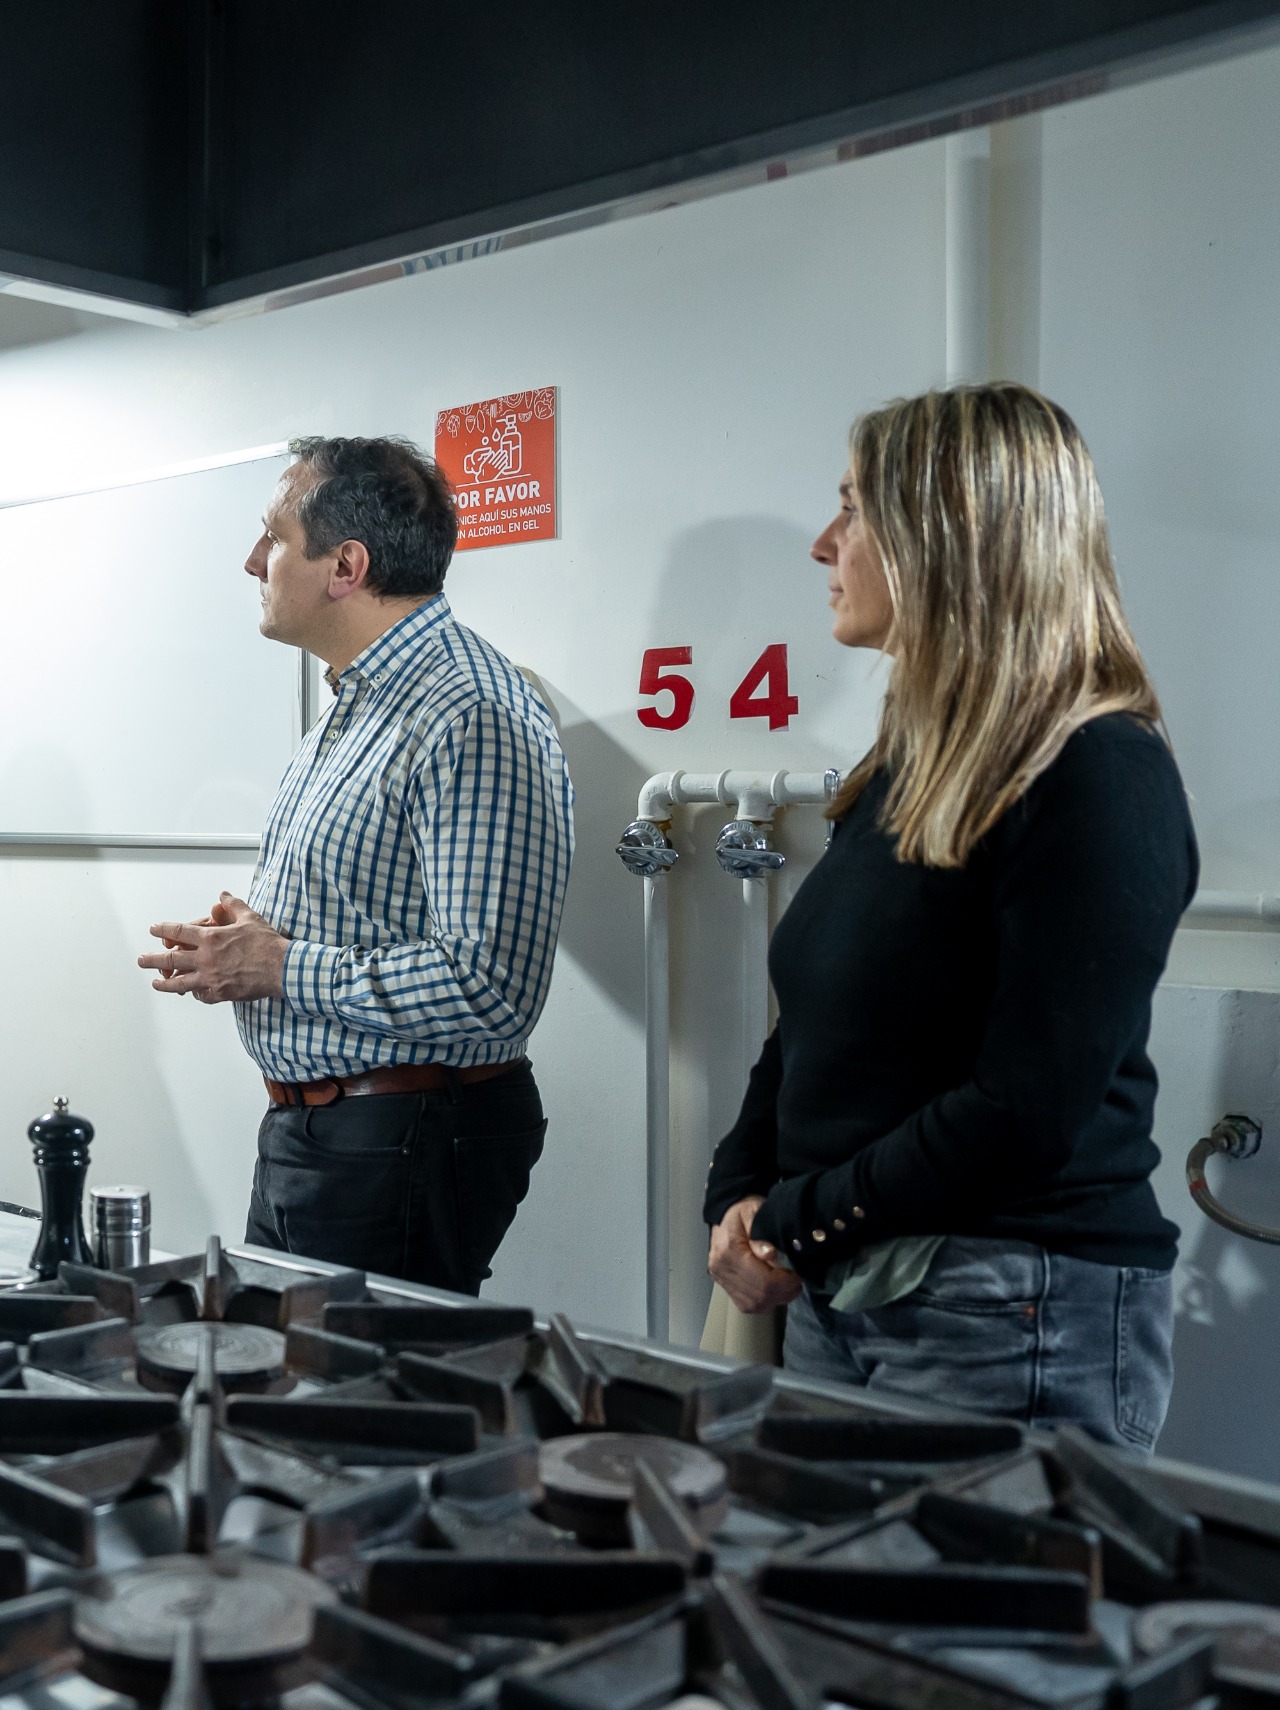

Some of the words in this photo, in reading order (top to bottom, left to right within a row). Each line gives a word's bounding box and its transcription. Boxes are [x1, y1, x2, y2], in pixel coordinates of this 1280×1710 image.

[485, 481, 541, 505] FAVOR
[457, 515, 477, 527] NICE
[479, 509, 499, 523] AQUÍ
[501, 508, 518, 520] SUS
[520, 504, 552, 517] MANOS
[468, 524, 507, 538] ALCOHOL
[509, 522, 521, 533] EN
[523, 519, 540, 531] GEL
[637, 646, 694, 731] 5
[730, 643, 799, 732] 4
